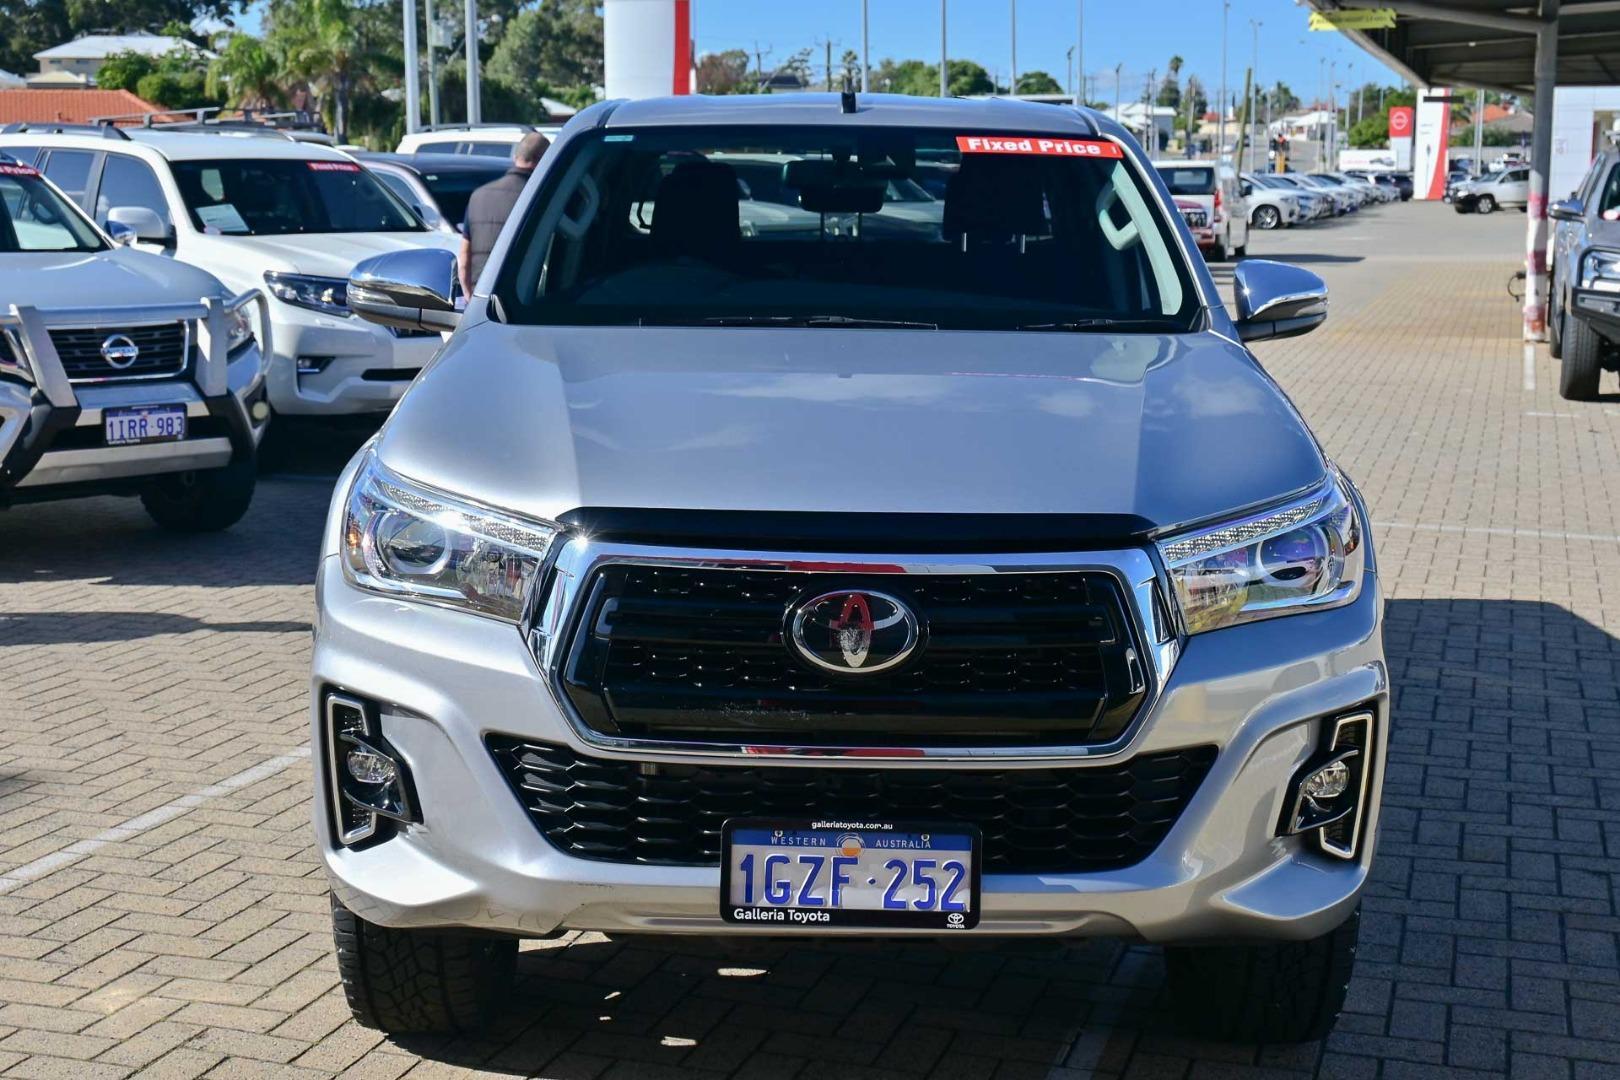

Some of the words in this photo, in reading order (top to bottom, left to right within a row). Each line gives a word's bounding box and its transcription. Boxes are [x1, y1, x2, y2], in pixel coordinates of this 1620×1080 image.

[967, 138, 1033, 152] Fixed
[1038, 140, 1101, 155] Price
[811, 820, 893, 831] galleriatoyota.com.au
[771, 836, 827, 846] WESTERN
[875, 839, 931, 849] AUSTRALIA
[733, 908, 785, 921] Galleria
[788, 909, 830, 923] Toyota
